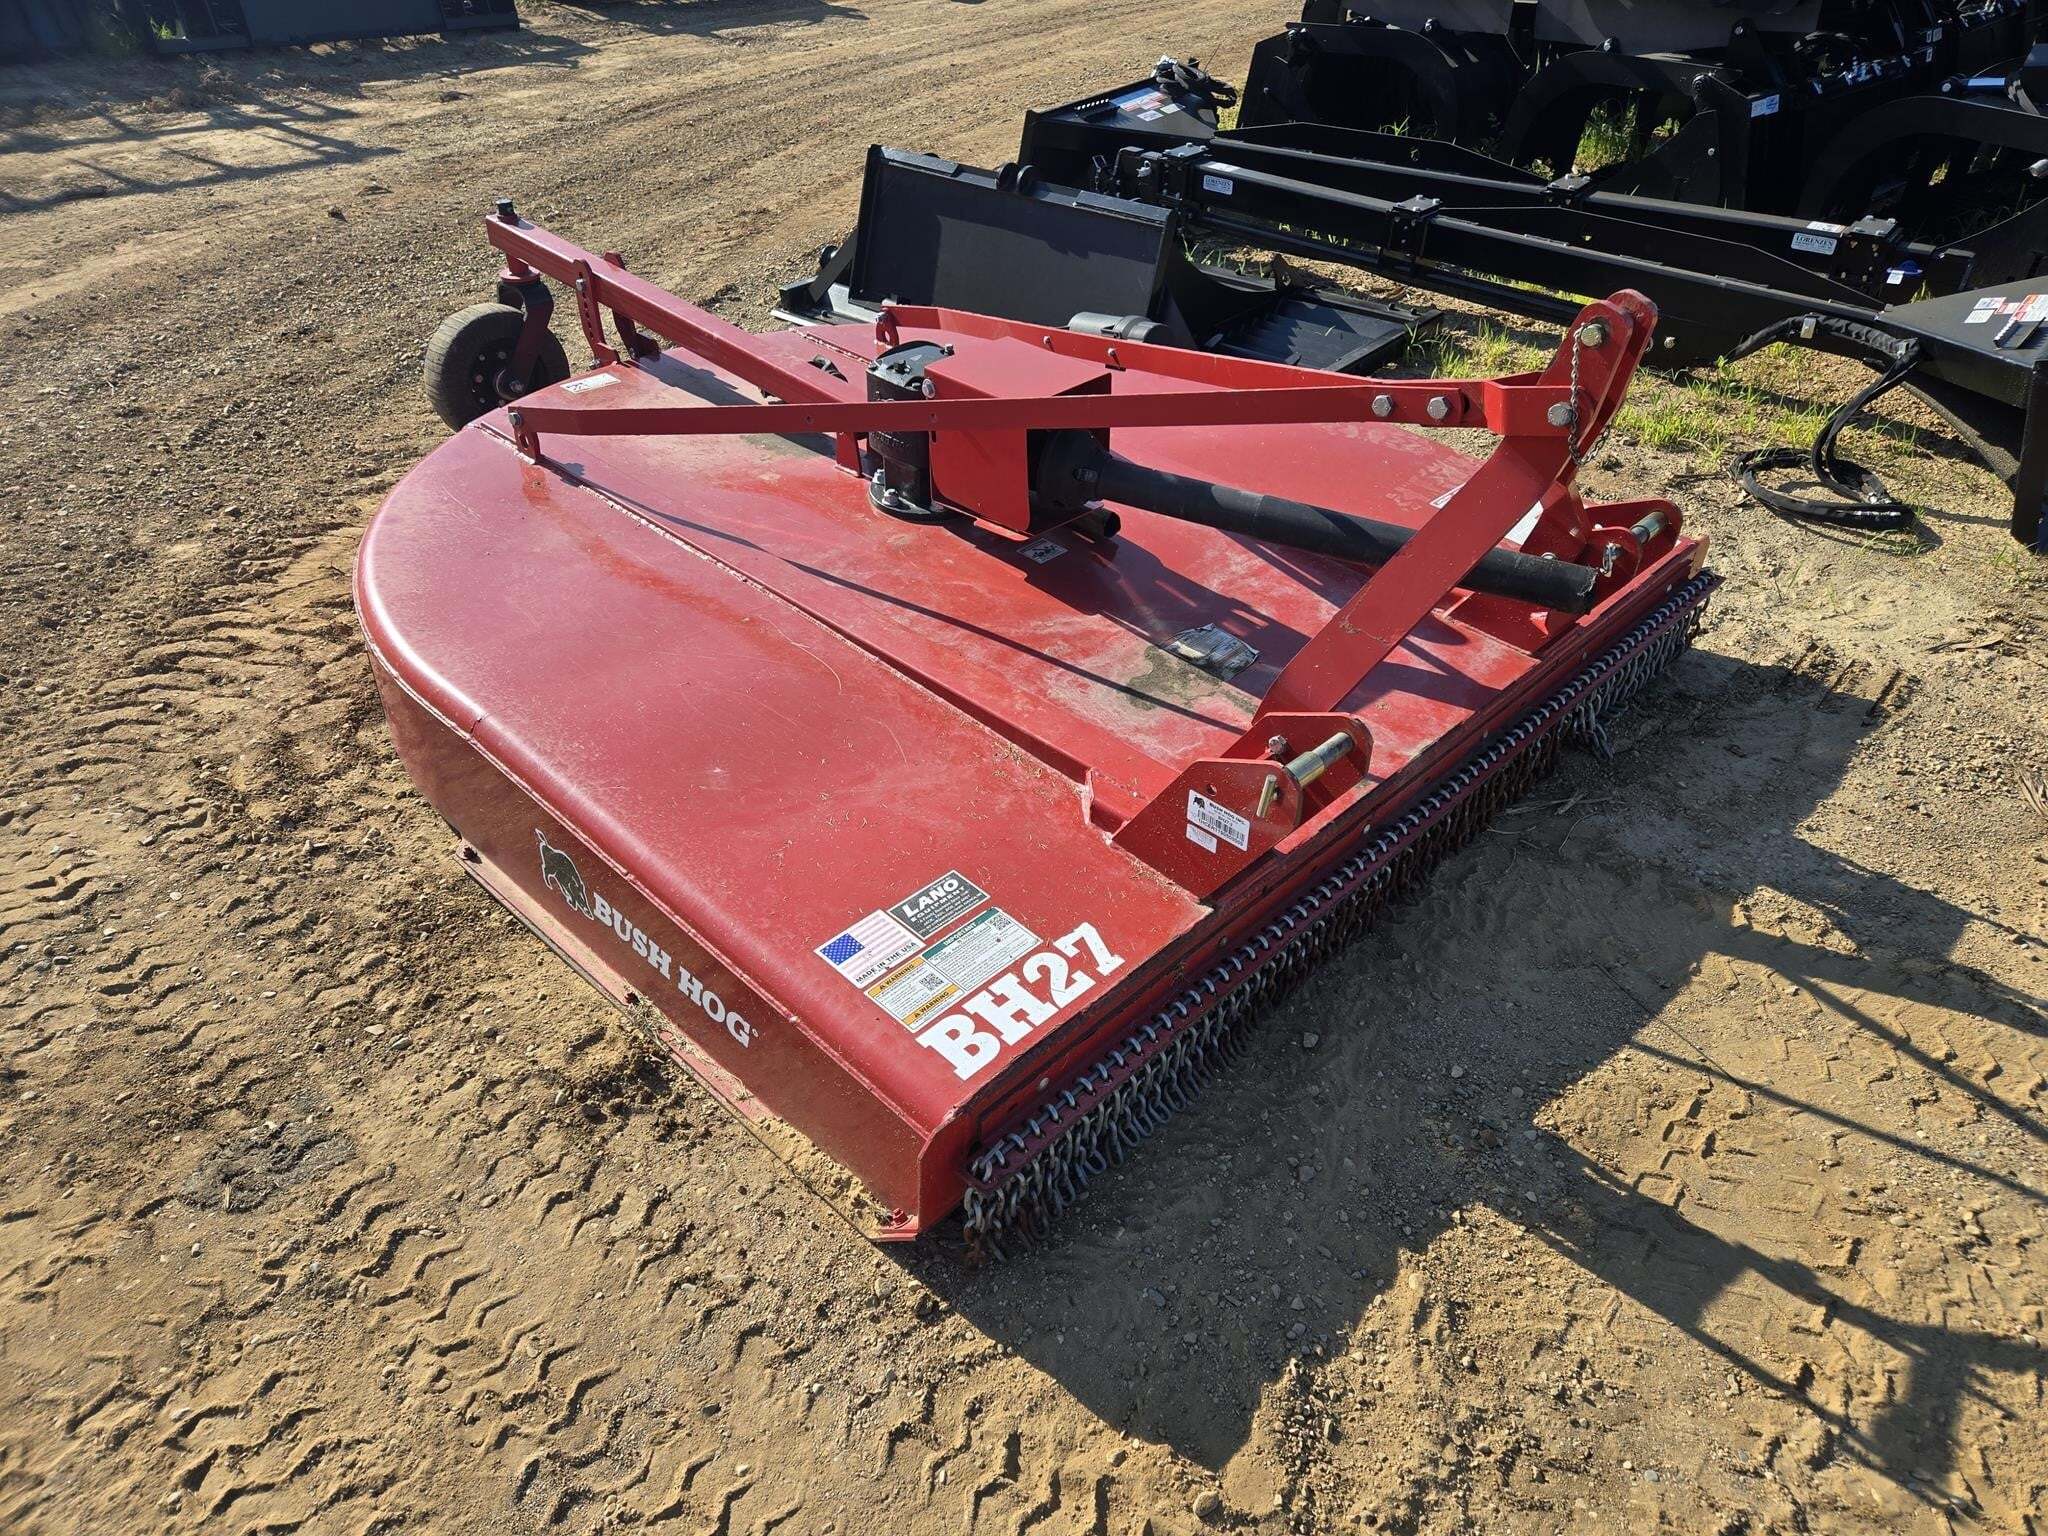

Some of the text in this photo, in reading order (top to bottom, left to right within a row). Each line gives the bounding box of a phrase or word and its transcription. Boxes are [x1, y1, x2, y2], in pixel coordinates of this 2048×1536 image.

[902, 878, 959, 918] LANO
[910, 887, 965, 923] EQUIPMENT
[593, 892, 672, 979] BUSH
[941, 921, 979, 946] IMPORTANT
[853, 940, 917, 983] MADE IN THE USA
[884, 963, 915, 986] WARNING
[916, 922, 1125, 1081] BH27
[920, 991, 950, 1014] WARNING
